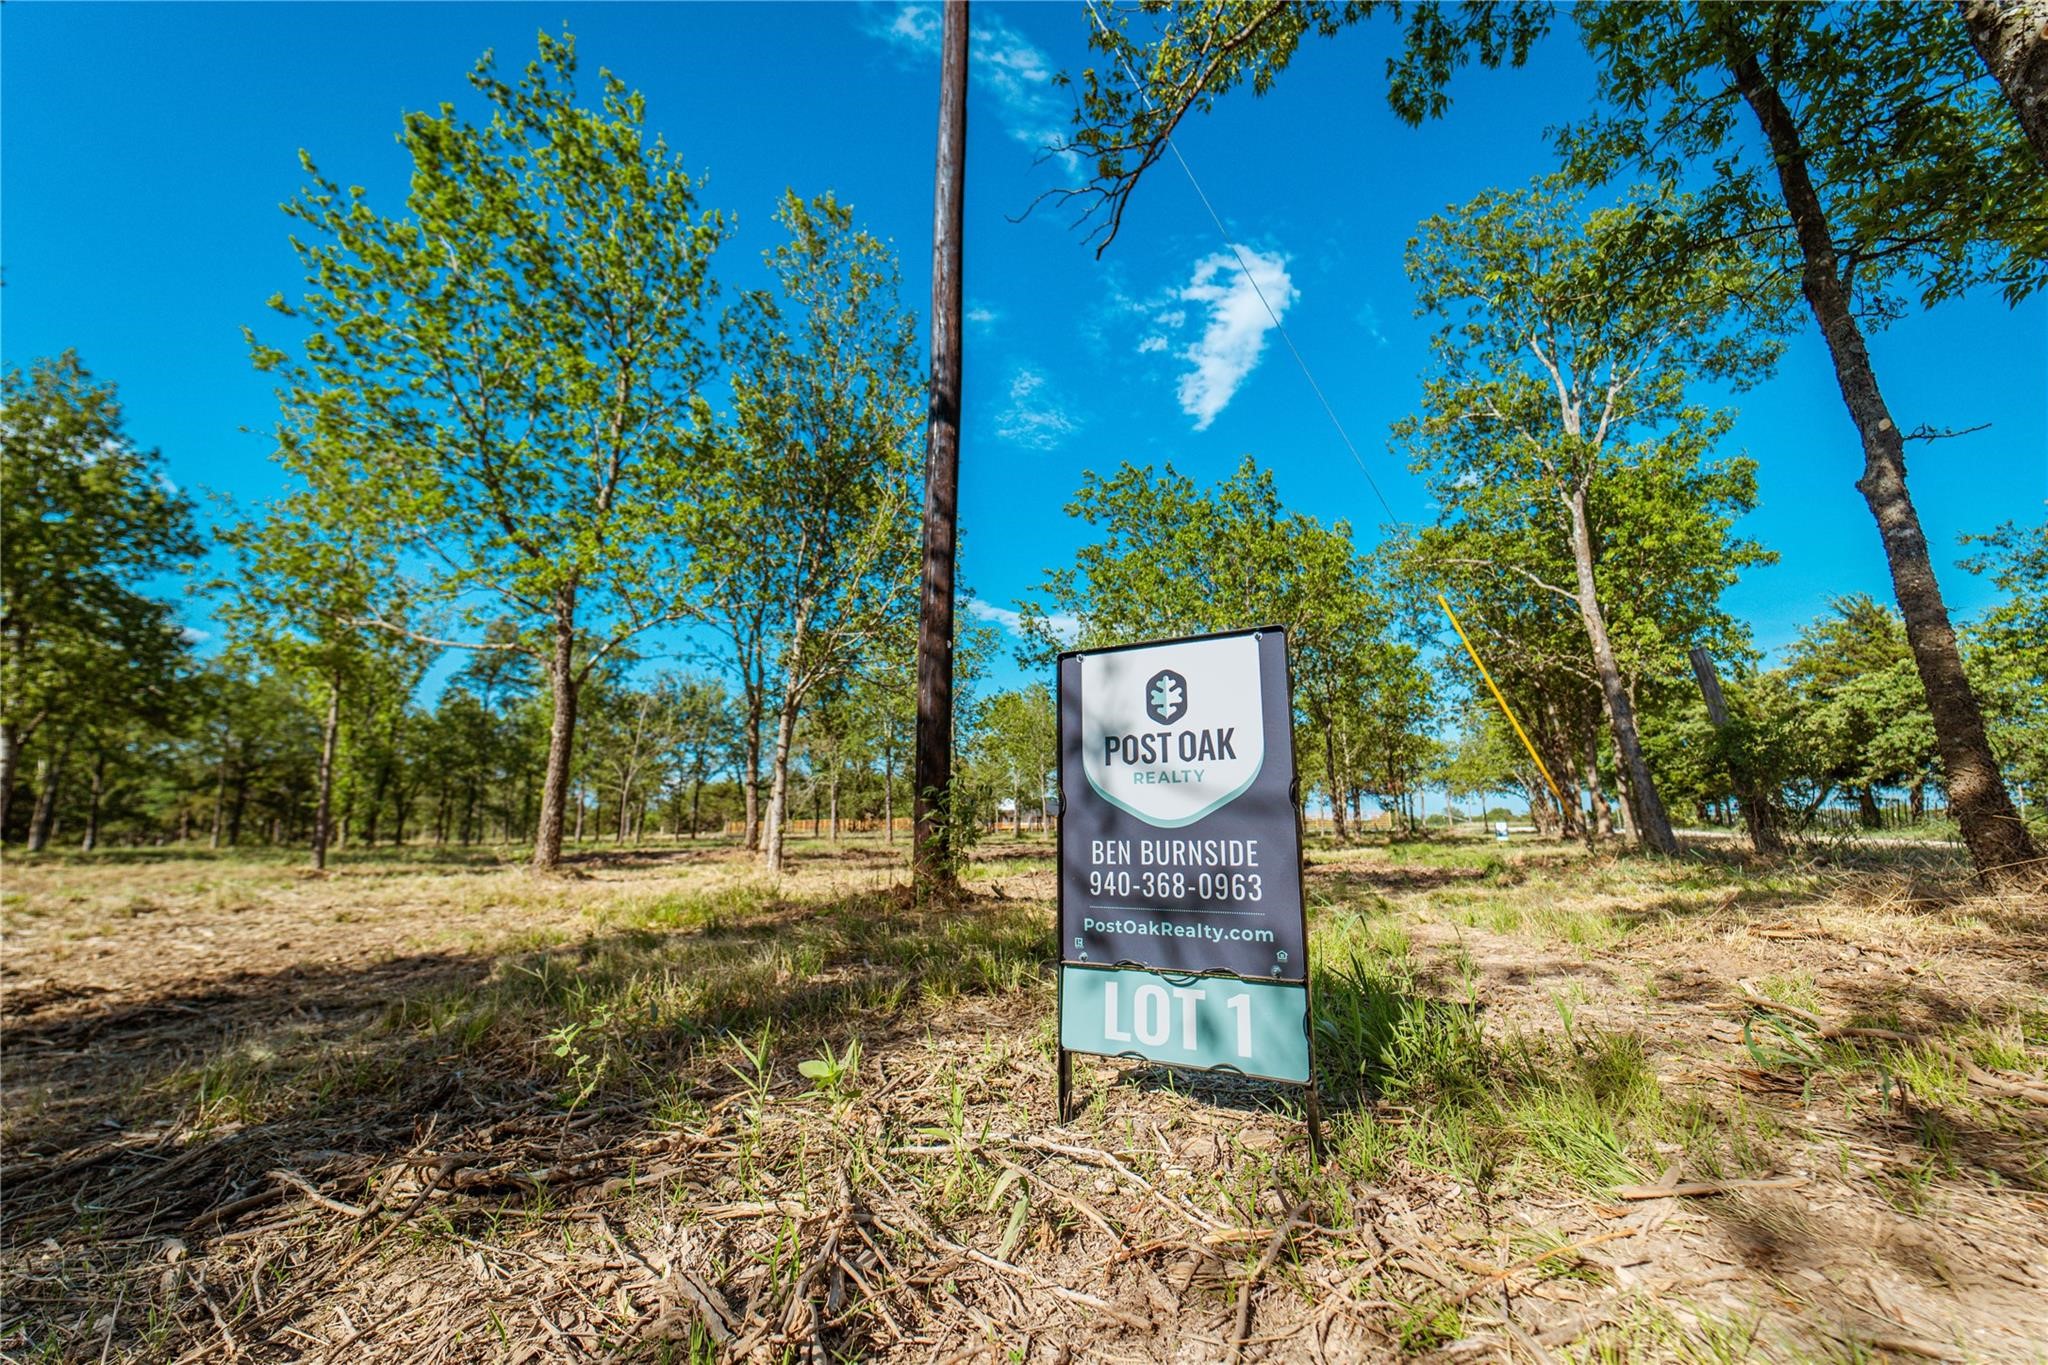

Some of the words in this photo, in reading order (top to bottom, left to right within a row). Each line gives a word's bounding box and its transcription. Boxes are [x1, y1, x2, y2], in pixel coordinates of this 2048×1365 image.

[1104, 732, 1171, 766] POST
[1178, 727, 1236, 763] OAK
[1133, 769, 1204, 785] REALTY
[1091, 840, 1131, 865] BEN
[1140, 840, 1259, 867] BURNSIDE
[1089, 871, 1262, 901] 940-368-0963
[1084, 918, 1274, 943] PostOakRealty.com
[1104, 981, 1206, 1051] LOT
[1227, 993, 1251, 1058] 1
